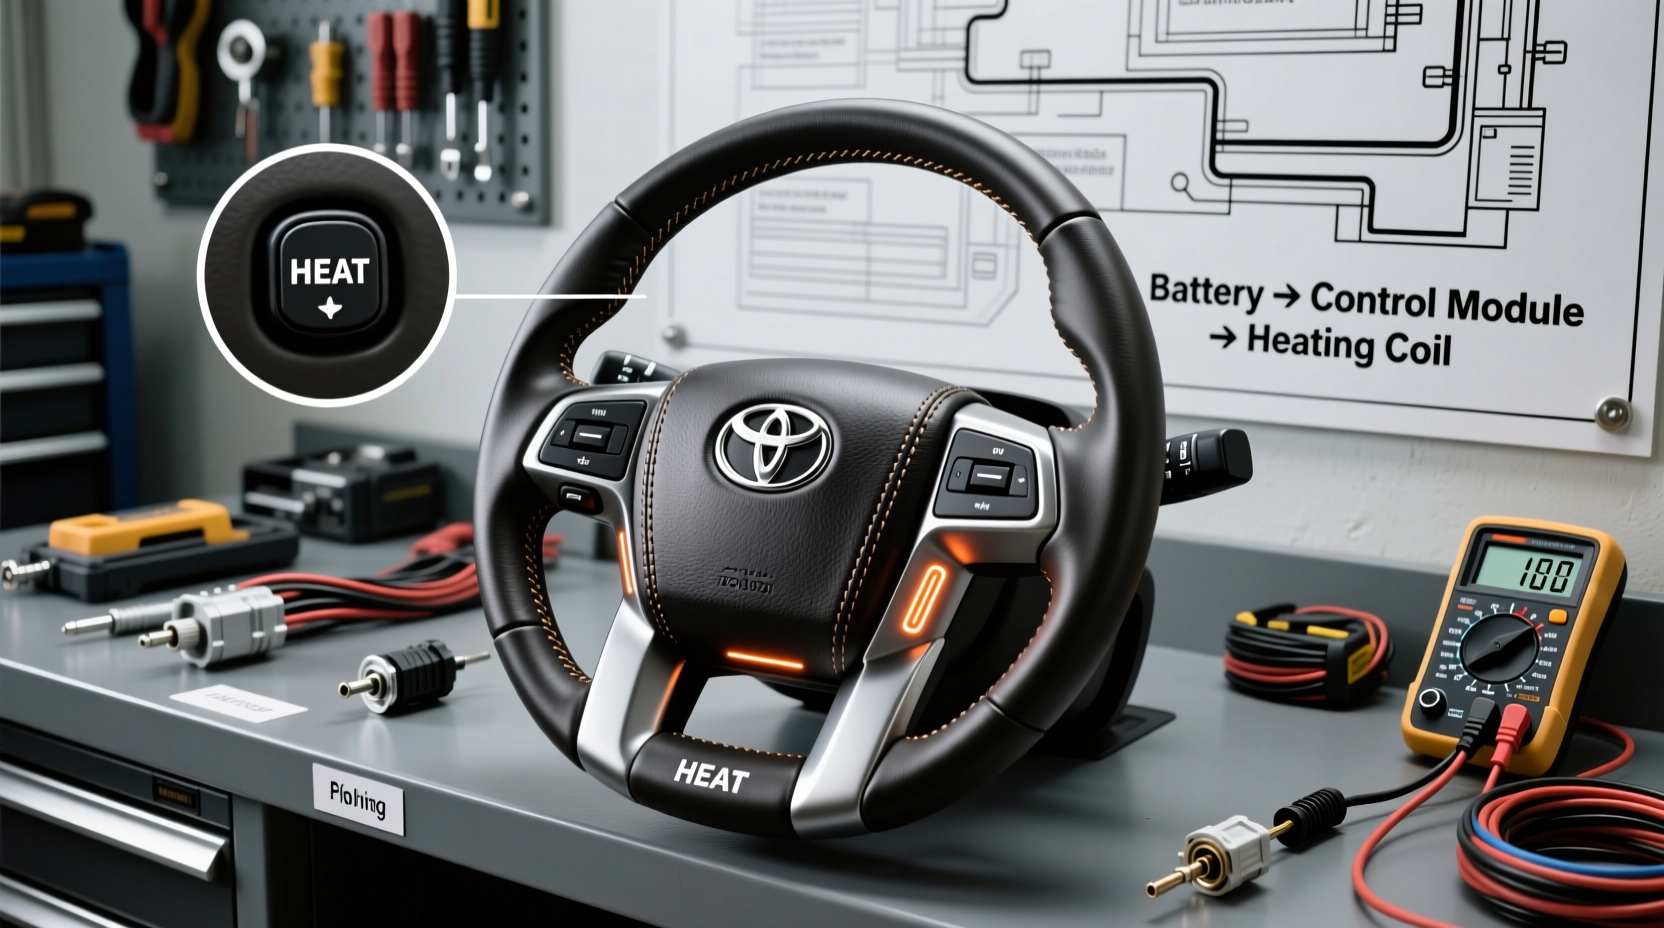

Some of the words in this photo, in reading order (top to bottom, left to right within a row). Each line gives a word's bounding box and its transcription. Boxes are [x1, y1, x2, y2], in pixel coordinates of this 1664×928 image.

[291, 258, 371, 285] HEAT
[1150, 273, 1265, 315] Battery
[1310, 281, 1437, 318] Control
[1447, 288, 1585, 328] Module
[1247, 323, 1375, 369] Heating
[1385, 332, 1452, 367] Coil
[673, 758, 751, 794] HEAT
